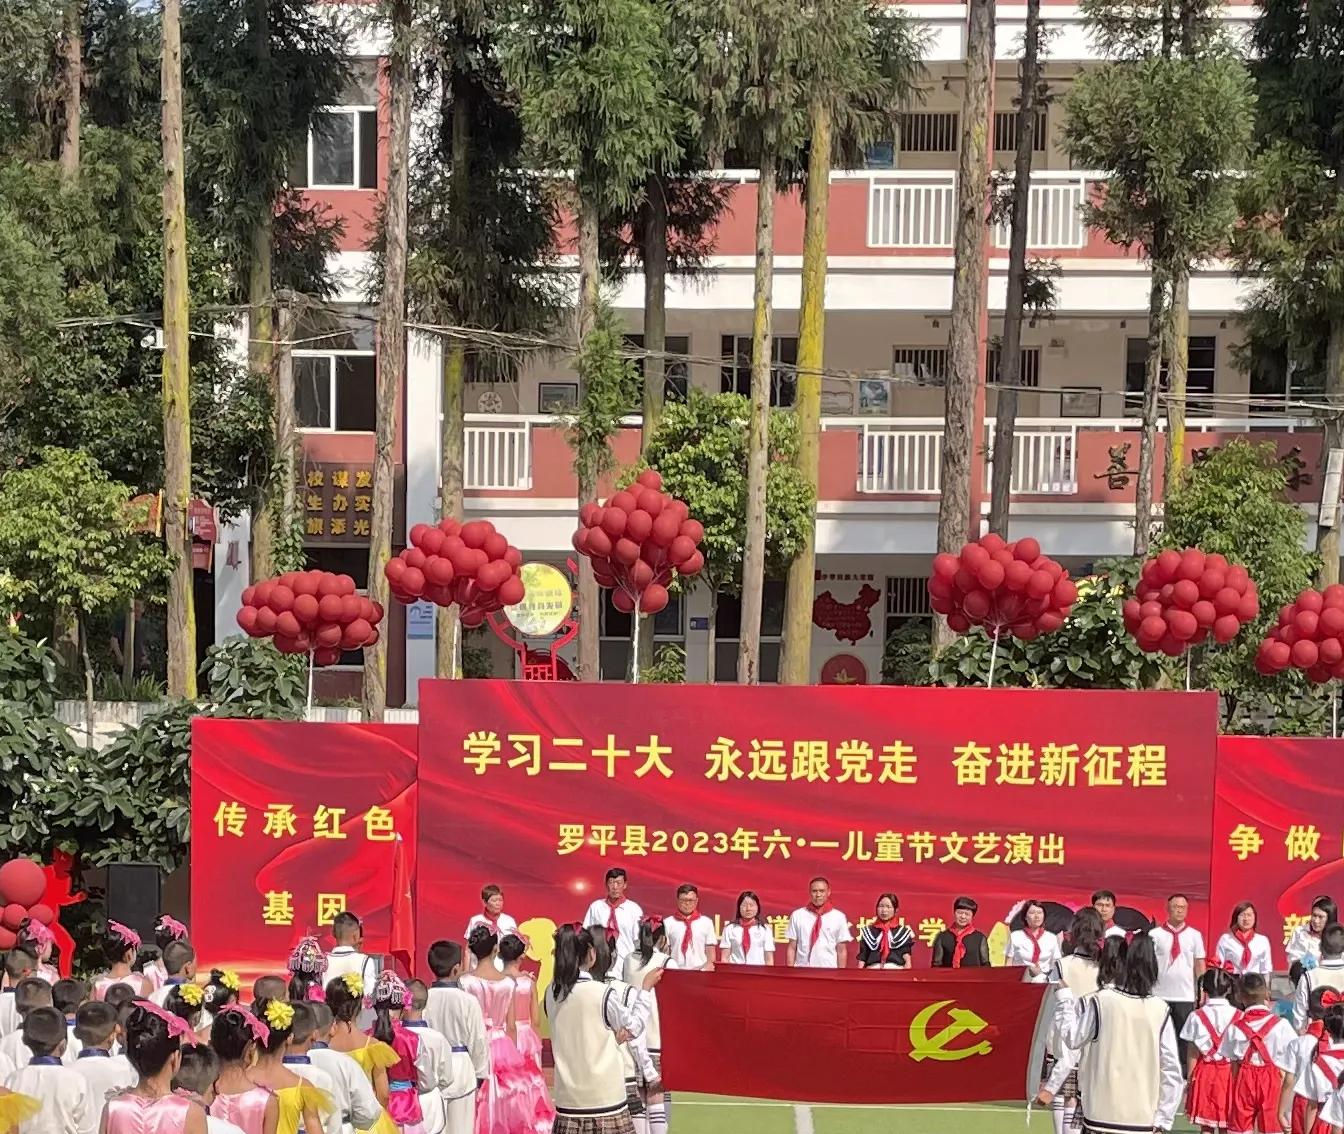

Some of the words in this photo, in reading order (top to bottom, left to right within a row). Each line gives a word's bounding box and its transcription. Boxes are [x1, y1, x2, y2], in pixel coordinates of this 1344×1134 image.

[463, 731, 674, 778] 学习二十大
[704, 737, 918, 784] 永远跟党走
[951, 741, 1167, 787] 奋进新征程
[213, 801, 396, 841] 传承红色
[262, 890, 346, 926] 基因
